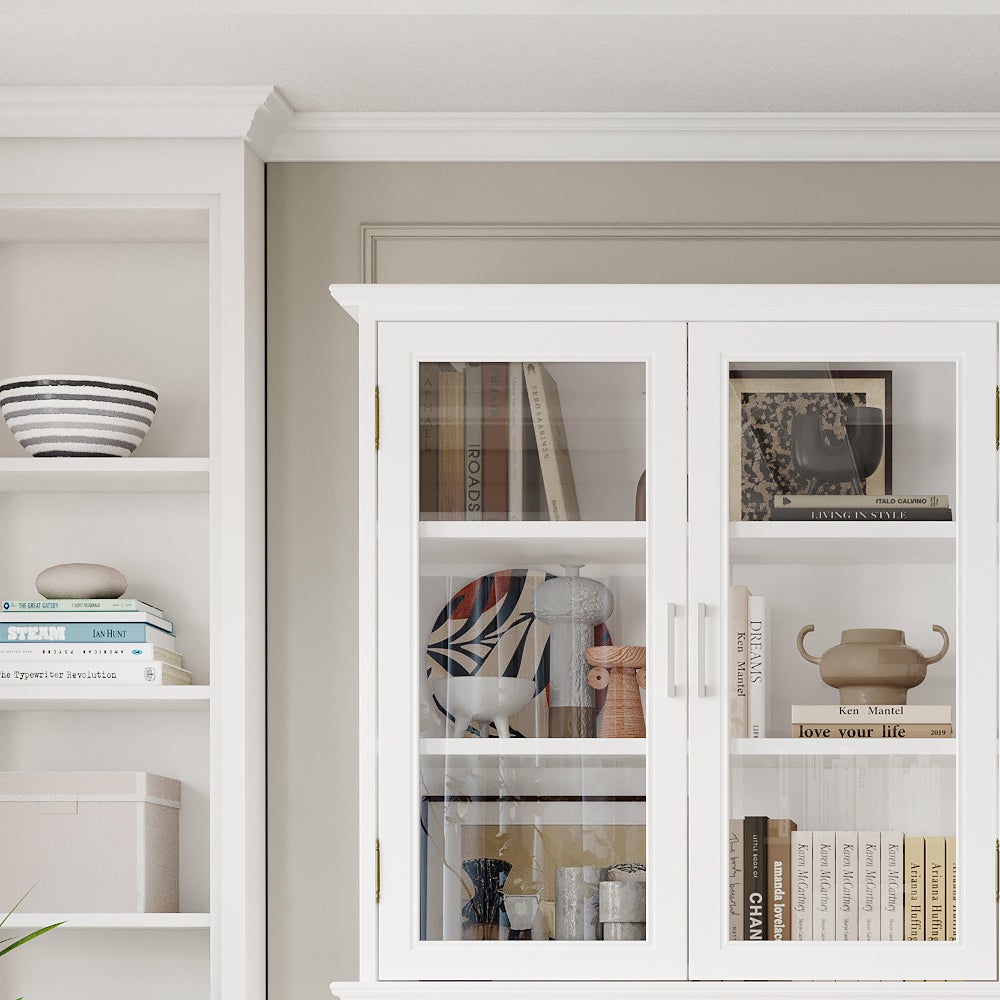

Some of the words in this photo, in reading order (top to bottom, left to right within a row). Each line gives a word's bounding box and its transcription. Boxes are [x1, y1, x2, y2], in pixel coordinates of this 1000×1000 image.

[469, 449, 481, 512] ROADS
[811, 511, 851, 519] LIVING
[855, 511, 867, 519] IN
[870, 511, 907, 519] STYLE
[7, 626, 66, 641] STEAM
[93, 629, 106, 638] IAN
[107, 629, 127, 638] HUNT
[737, 632, 746, 653] Ken
[749, 621, 763, 684] DREAMS
[14, 671, 64, 681] Typewriter
[67, 671, 117, 679] Revolution
[737, 661, 746, 698] Mantel
[838, 706, 860, 715] Ken
[867, 706, 904, 715] Mantel
[799, 725, 831, 738] love
[838, 729, 874, 738] your
[882, 725, 906, 738] life
[798, 843, 808, 868] Karen
[820, 843, 831, 868] Karen
[842, 843, 854, 868] Karen
[865, 843, 876, 868] Karen
[888, 843, 898, 868] Karen
[773, 861, 786, 901] amanda
[794, 869, 808, 913] McCartney
[816, 869, 831, 913] McCartney
[839, 869, 854, 913] McCartney
[862, 869, 876, 913] McCartney
[884, 869, 898, 913] McCartney
[910, 862, 921, 901] Arianna
[931, 862, 942, 901] Arianna
[773, 904, 786, 941] lovelac
